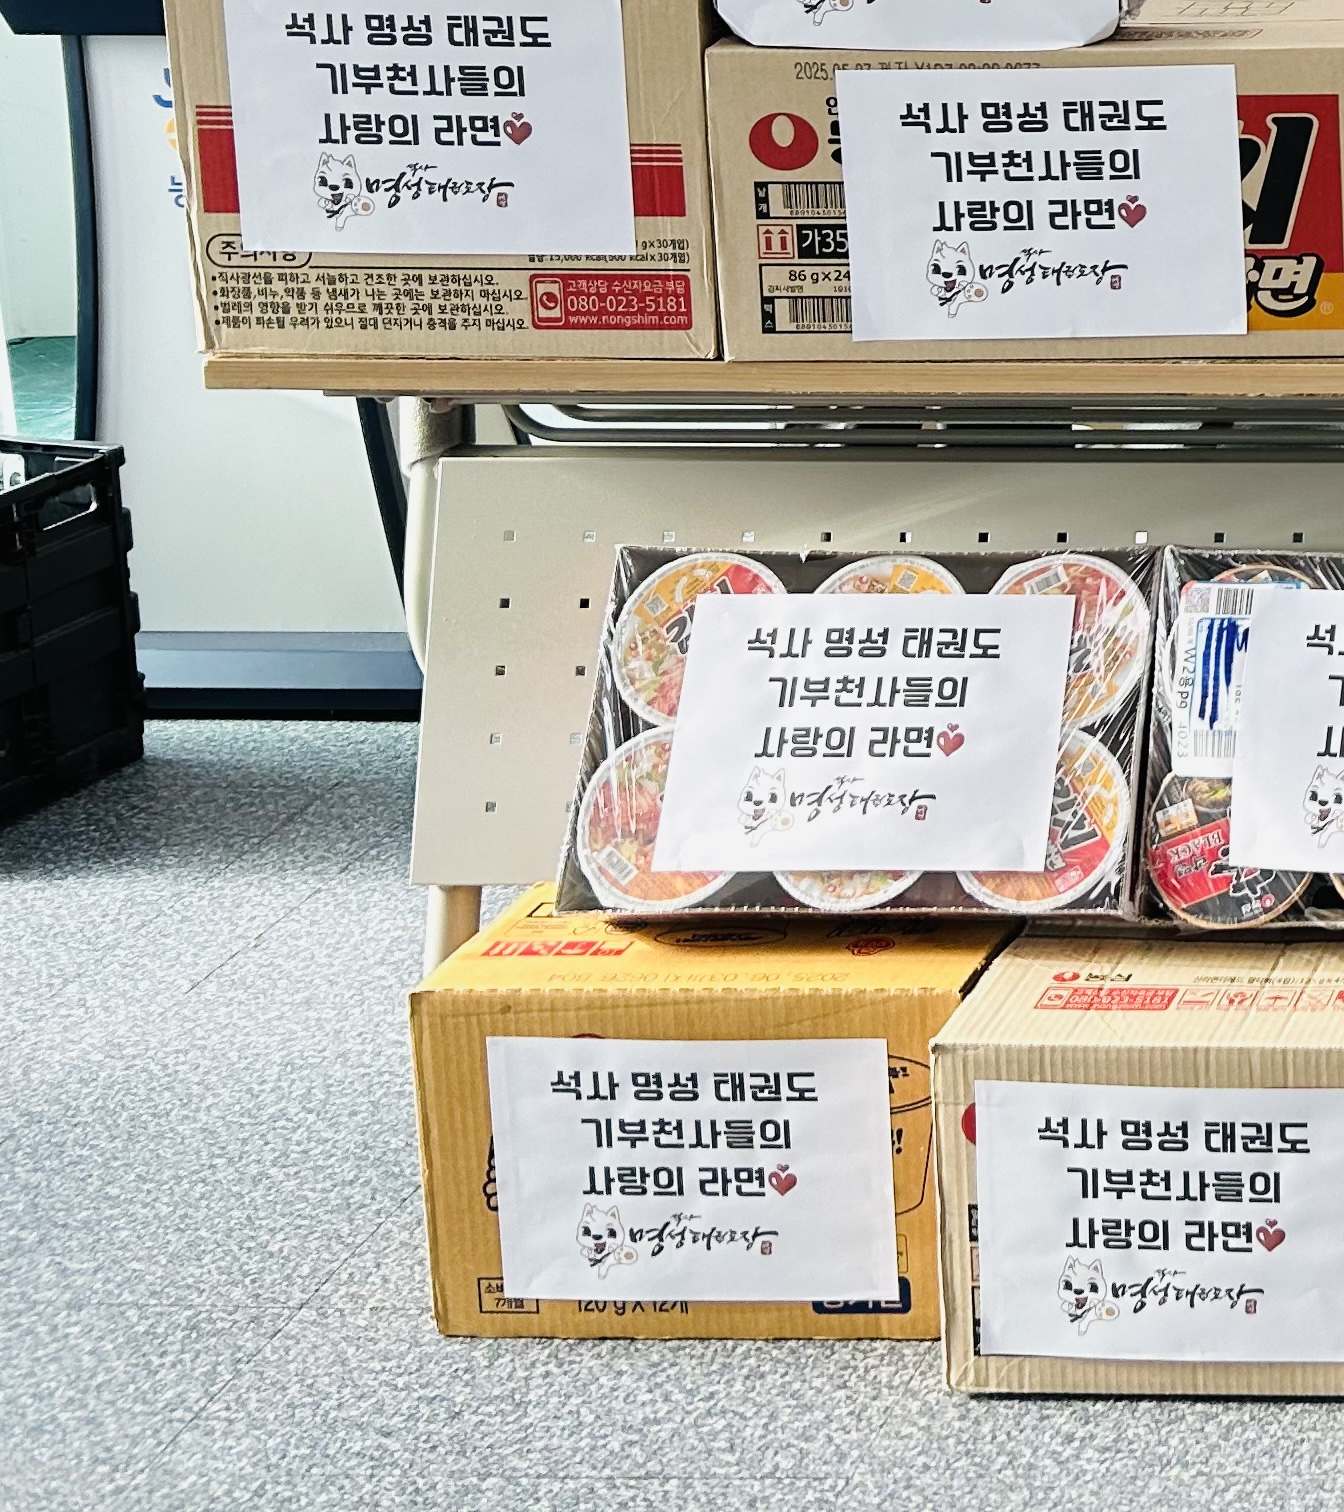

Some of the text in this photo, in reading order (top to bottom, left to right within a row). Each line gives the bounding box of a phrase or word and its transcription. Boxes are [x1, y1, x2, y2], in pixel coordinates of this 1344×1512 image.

[285, 13, 551, 47] 석사 명성 태권도
[316, 63, 525, 97] 기부천사들의
[319, 113, 503, 146] 사랑의 라면
[900, 100, 1167, 133] 석사 명성 태권도
[931, 149, 1140, 182] 기부천사들의
[933, 198, 1118, 231] 사랑의 라면
[567, 295, 687, 312] 080-023-5181
[569, 313, 688, 327] www.nongshim.com
[748, 627, 1001, 658] 석사 명성 태권도
[769, 676, 968, 707] 기부천사들의
[755, 727, 939, 757] 사랑의 라면
[551, 1071, 818, 1101] 석사 명성 태권도
[581, 1118, 791, 1149] 기부천사들의
[1038, 1117, 1310, 1153] 석사 명성 태권도
[583, 1166, 769, 1197] 사랑의 라면
[1067, 1168, 1280, 1203] 기부천사들의
[1066, 1218, 1257, 1253] 사랑의 라면
